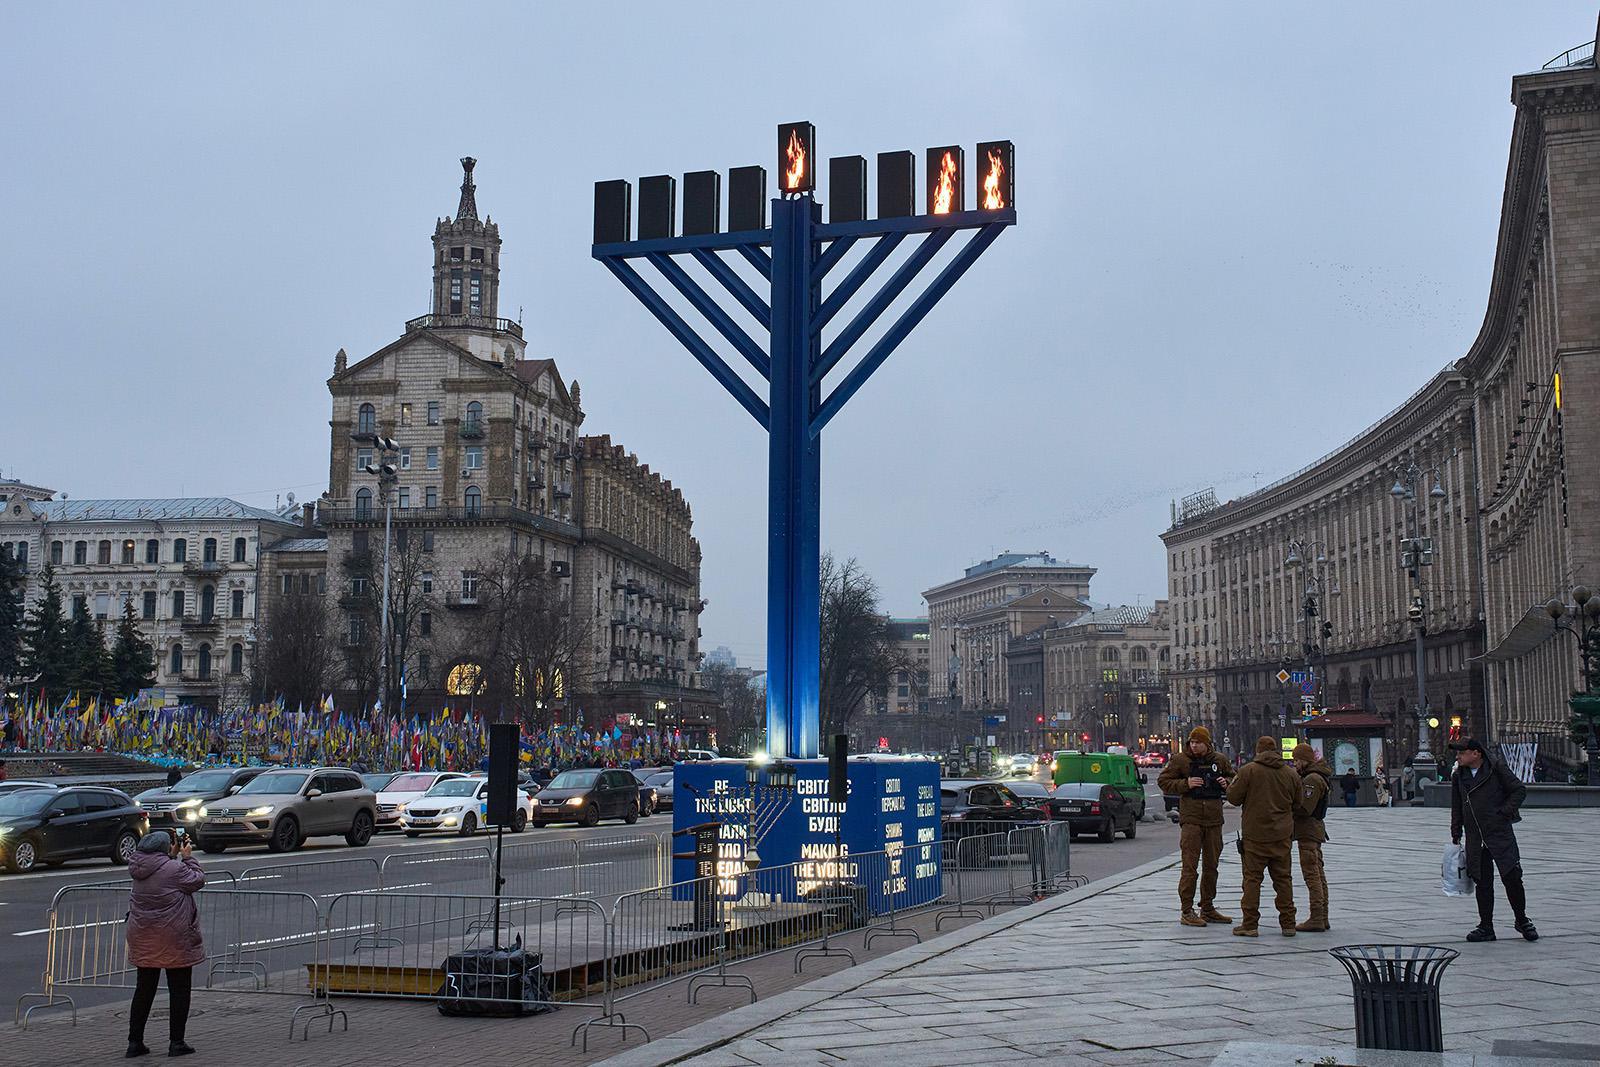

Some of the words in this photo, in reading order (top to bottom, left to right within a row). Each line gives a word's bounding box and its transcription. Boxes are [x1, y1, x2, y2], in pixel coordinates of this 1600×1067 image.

[714, 780, 728, 794] BE
[797, 779, 830, 794] СВІТЛ
[694, 798, 716, 812] THE
[718, 798, 752, 813] LIGHT
[802, 798, 846, 813] СВІТЛО
[801, 843, 848, 859] MAKING
[793, 862, 815, 878] THE
[815, 861, 858, 878] WORLD
